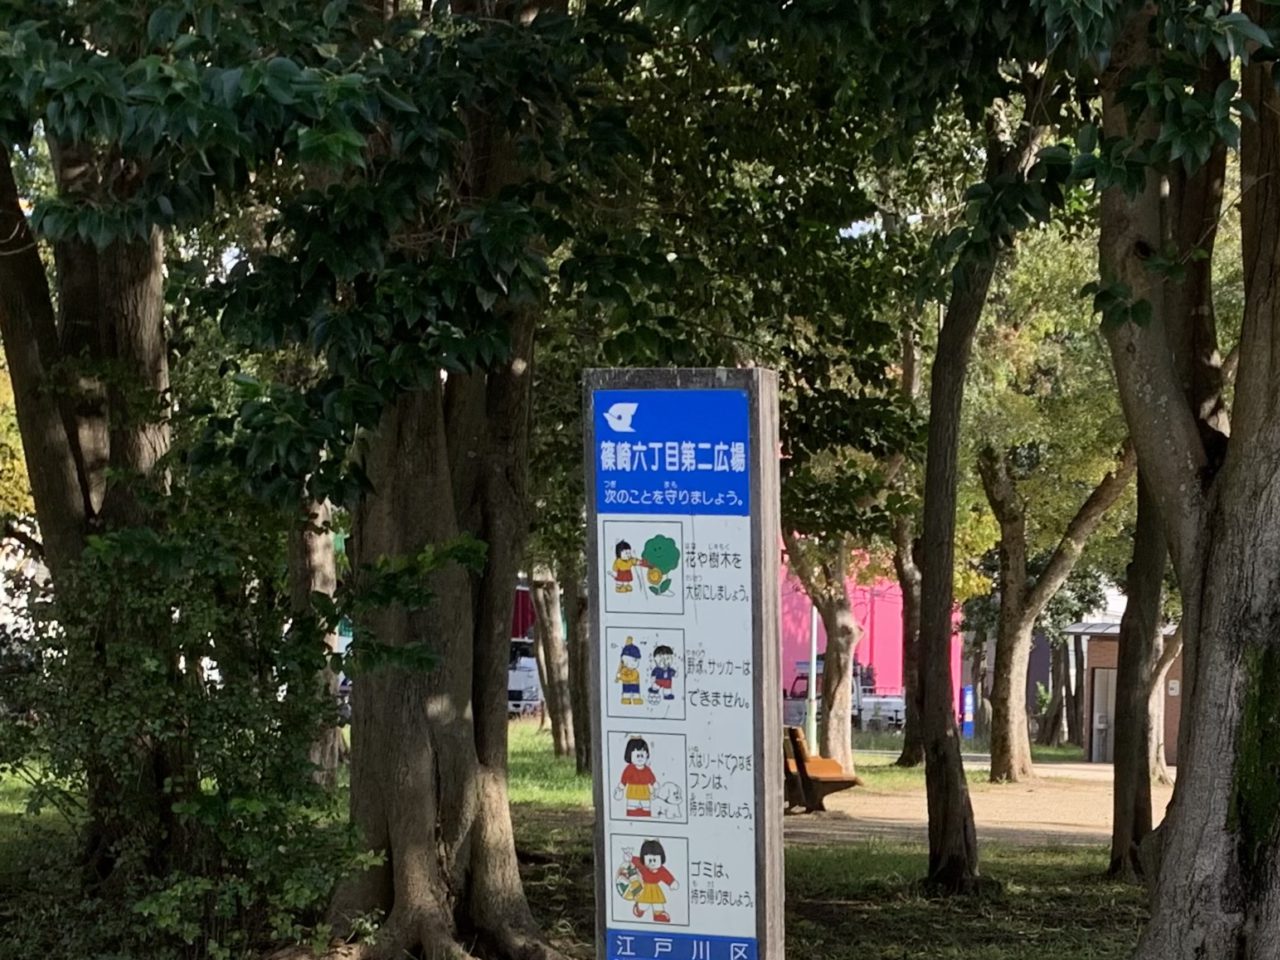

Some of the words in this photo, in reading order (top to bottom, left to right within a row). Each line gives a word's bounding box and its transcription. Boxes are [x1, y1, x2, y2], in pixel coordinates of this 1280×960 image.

[600, 439, 746, 472] 篠崎六丁目第二広場
[604, 489, 744, 507] 次のことを守りましょう。
[685, 551, 742, 569] 花や樹木を
[687, 689, 750, 709] できません。
[689, 773, 728, 790] フンは、
[691, 861, 730, 879] ゴミは、
